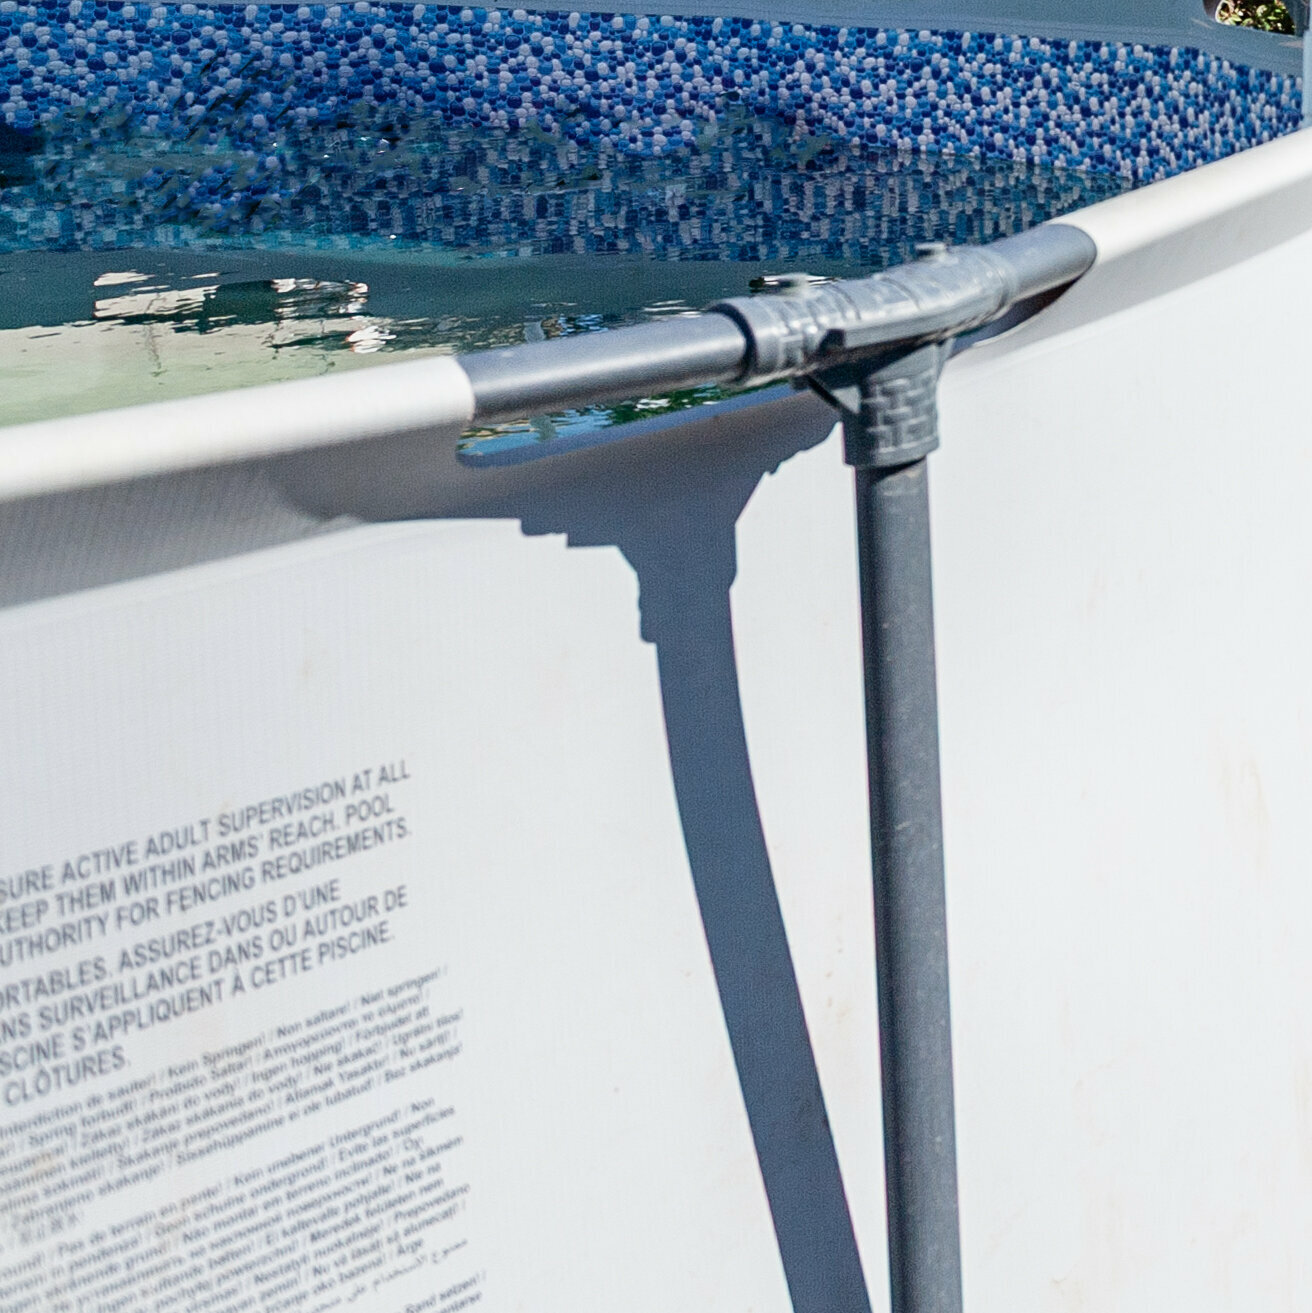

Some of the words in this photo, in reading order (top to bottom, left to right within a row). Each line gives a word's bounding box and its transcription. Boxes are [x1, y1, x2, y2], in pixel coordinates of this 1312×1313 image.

[55, 879, 116, 917] THEM
[123, 853, 197, 897] WITHIN
[268, 810, 341, 851] REACH.
[344, 793, 396, 827] POOL
[61, 839, 139, 885] ACTIVE
[145, 818, 211, 859] ADULT
[217, 777, 347, 838] SUPERVISION
[351, 768, 373, 796] AT
[378, 759, 411, 787] ALL
[115, 896, 160, 931] FOR
[166, 866, 257, 915] FENCING
[261, 816, 412, 884] REQUIREMENTS.
[38, 956, 203, 1031] SURVEILLANCE
[207, 935, 265, 975] DANS
[269, 923, 298, 953] OU
[303, 894, 380, 940] AUTOUR
[384, 885, 408, 912] DE
[119, 899, 278, 973] ASSUREZ-VOUS
[231, 966, 246, 997] À
[251, 947, 314, 990] CETTE
[317, 920, 396, 967] PISCINE.
